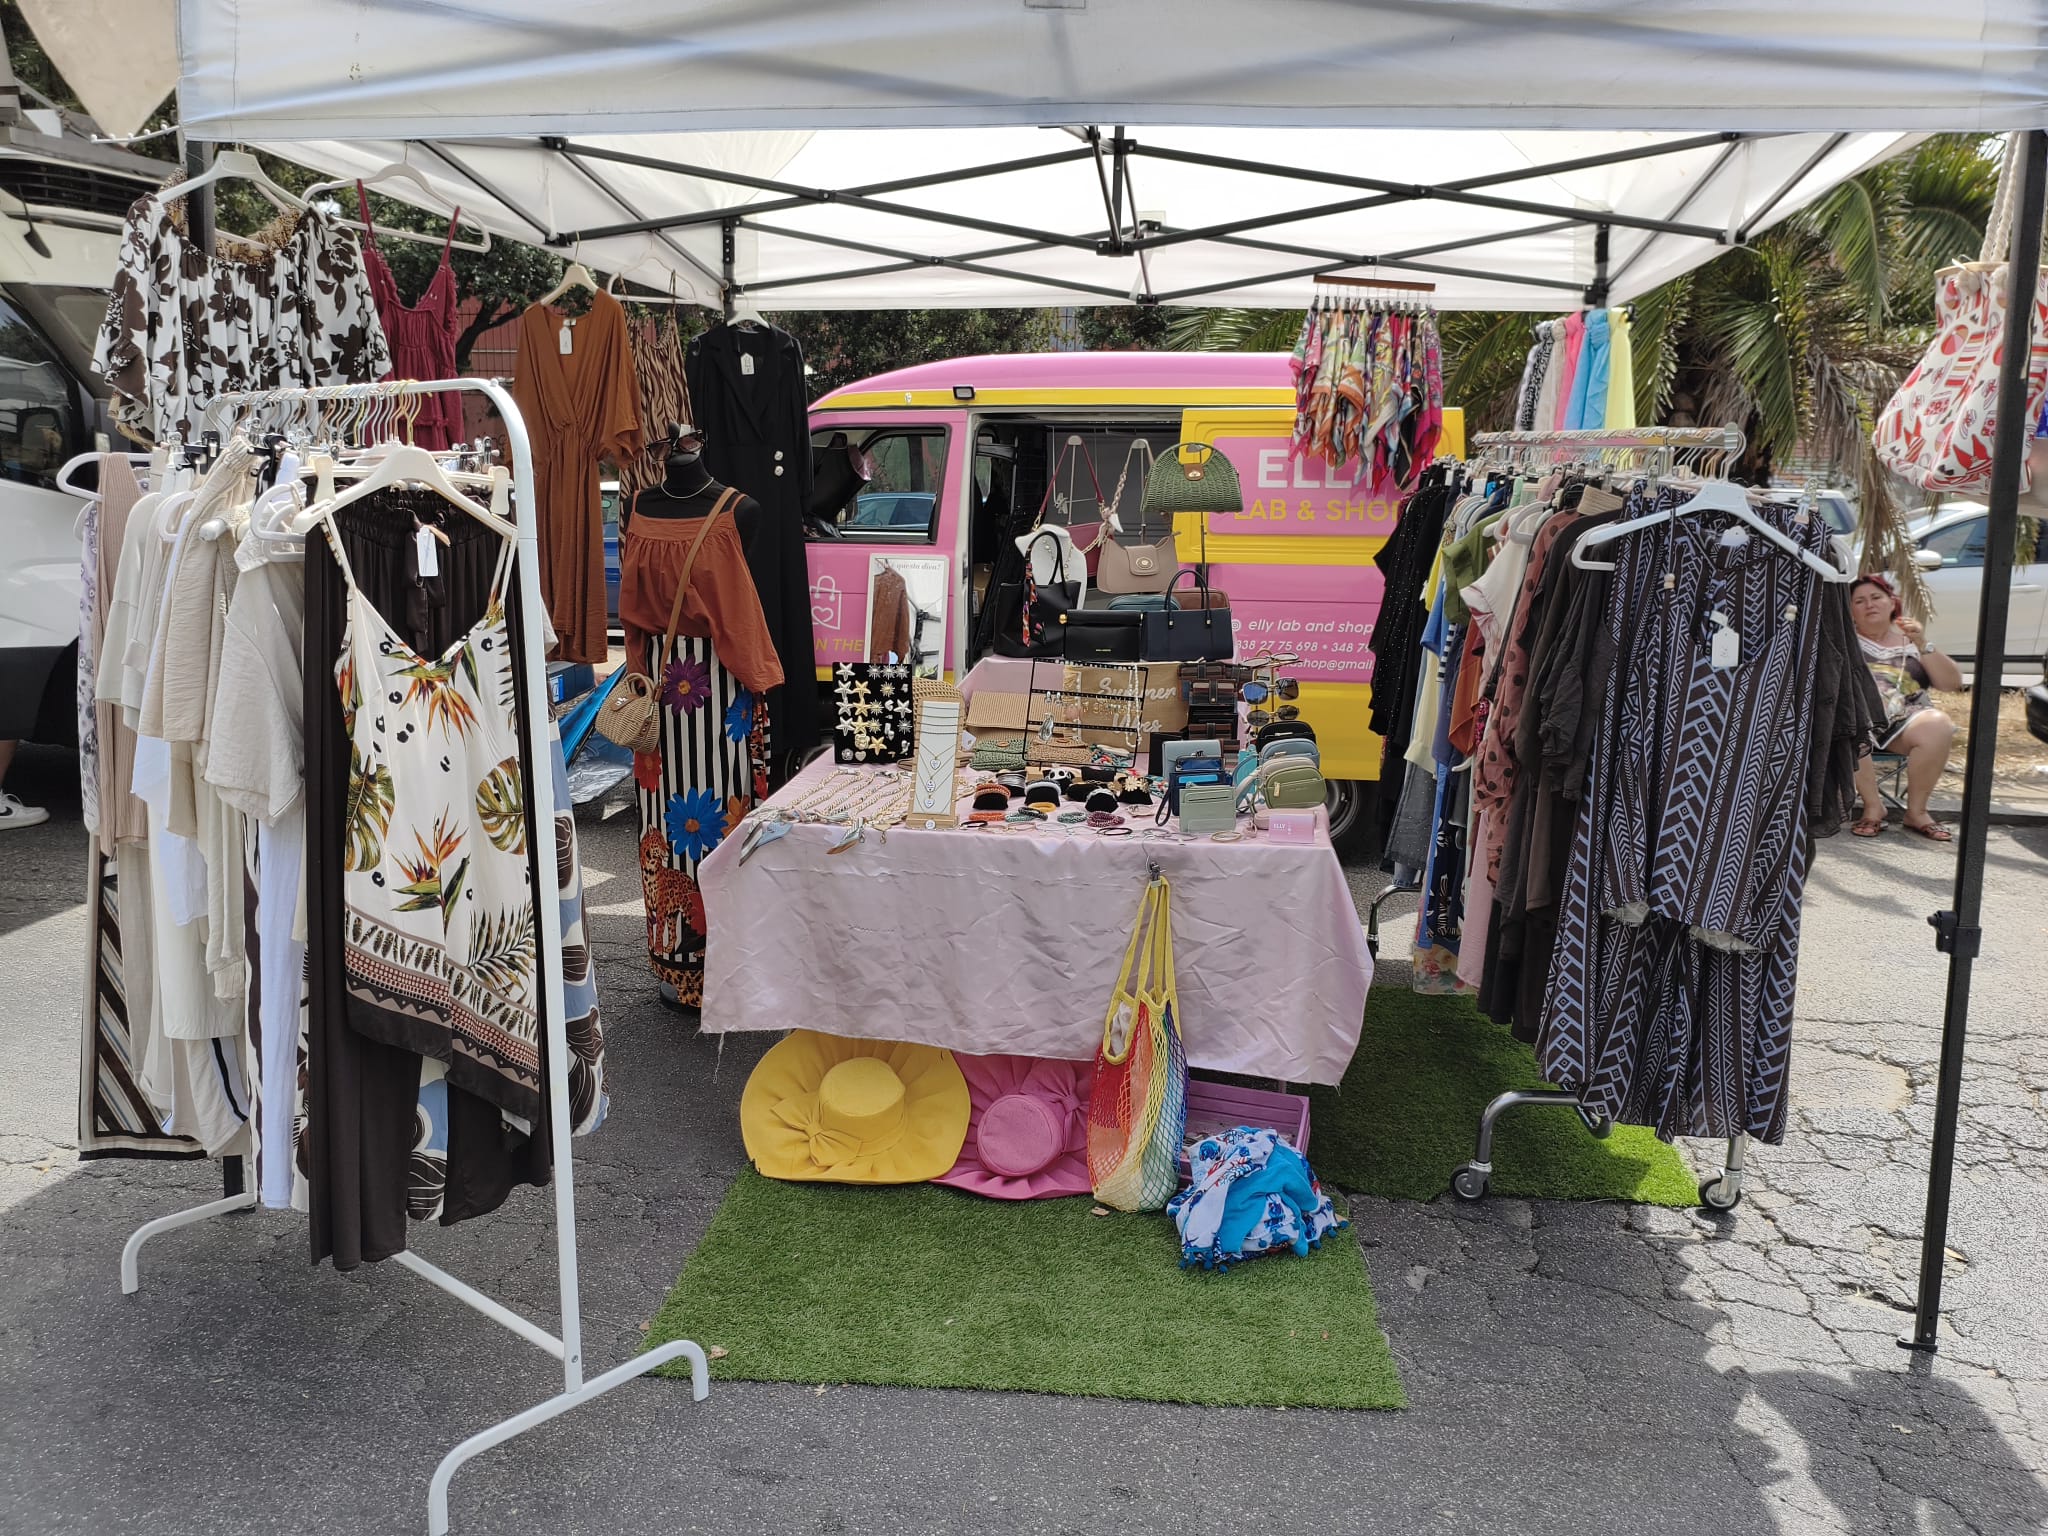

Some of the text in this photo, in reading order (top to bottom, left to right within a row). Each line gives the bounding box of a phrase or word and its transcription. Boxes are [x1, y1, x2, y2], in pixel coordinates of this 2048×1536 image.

[1258, 449, 1374, 489] ELL
[1296, 499, 1316, 521] &
[1248, 618, 1374, 635] elly lab and shop
[832, 638, 865, 653] THE
[1259, 640, 1275, 650] 27
[1278, 641, 1293, 651] 75
[1295, 641, 1318, 652] 698
[1331, 642, 1353, 653] 348
